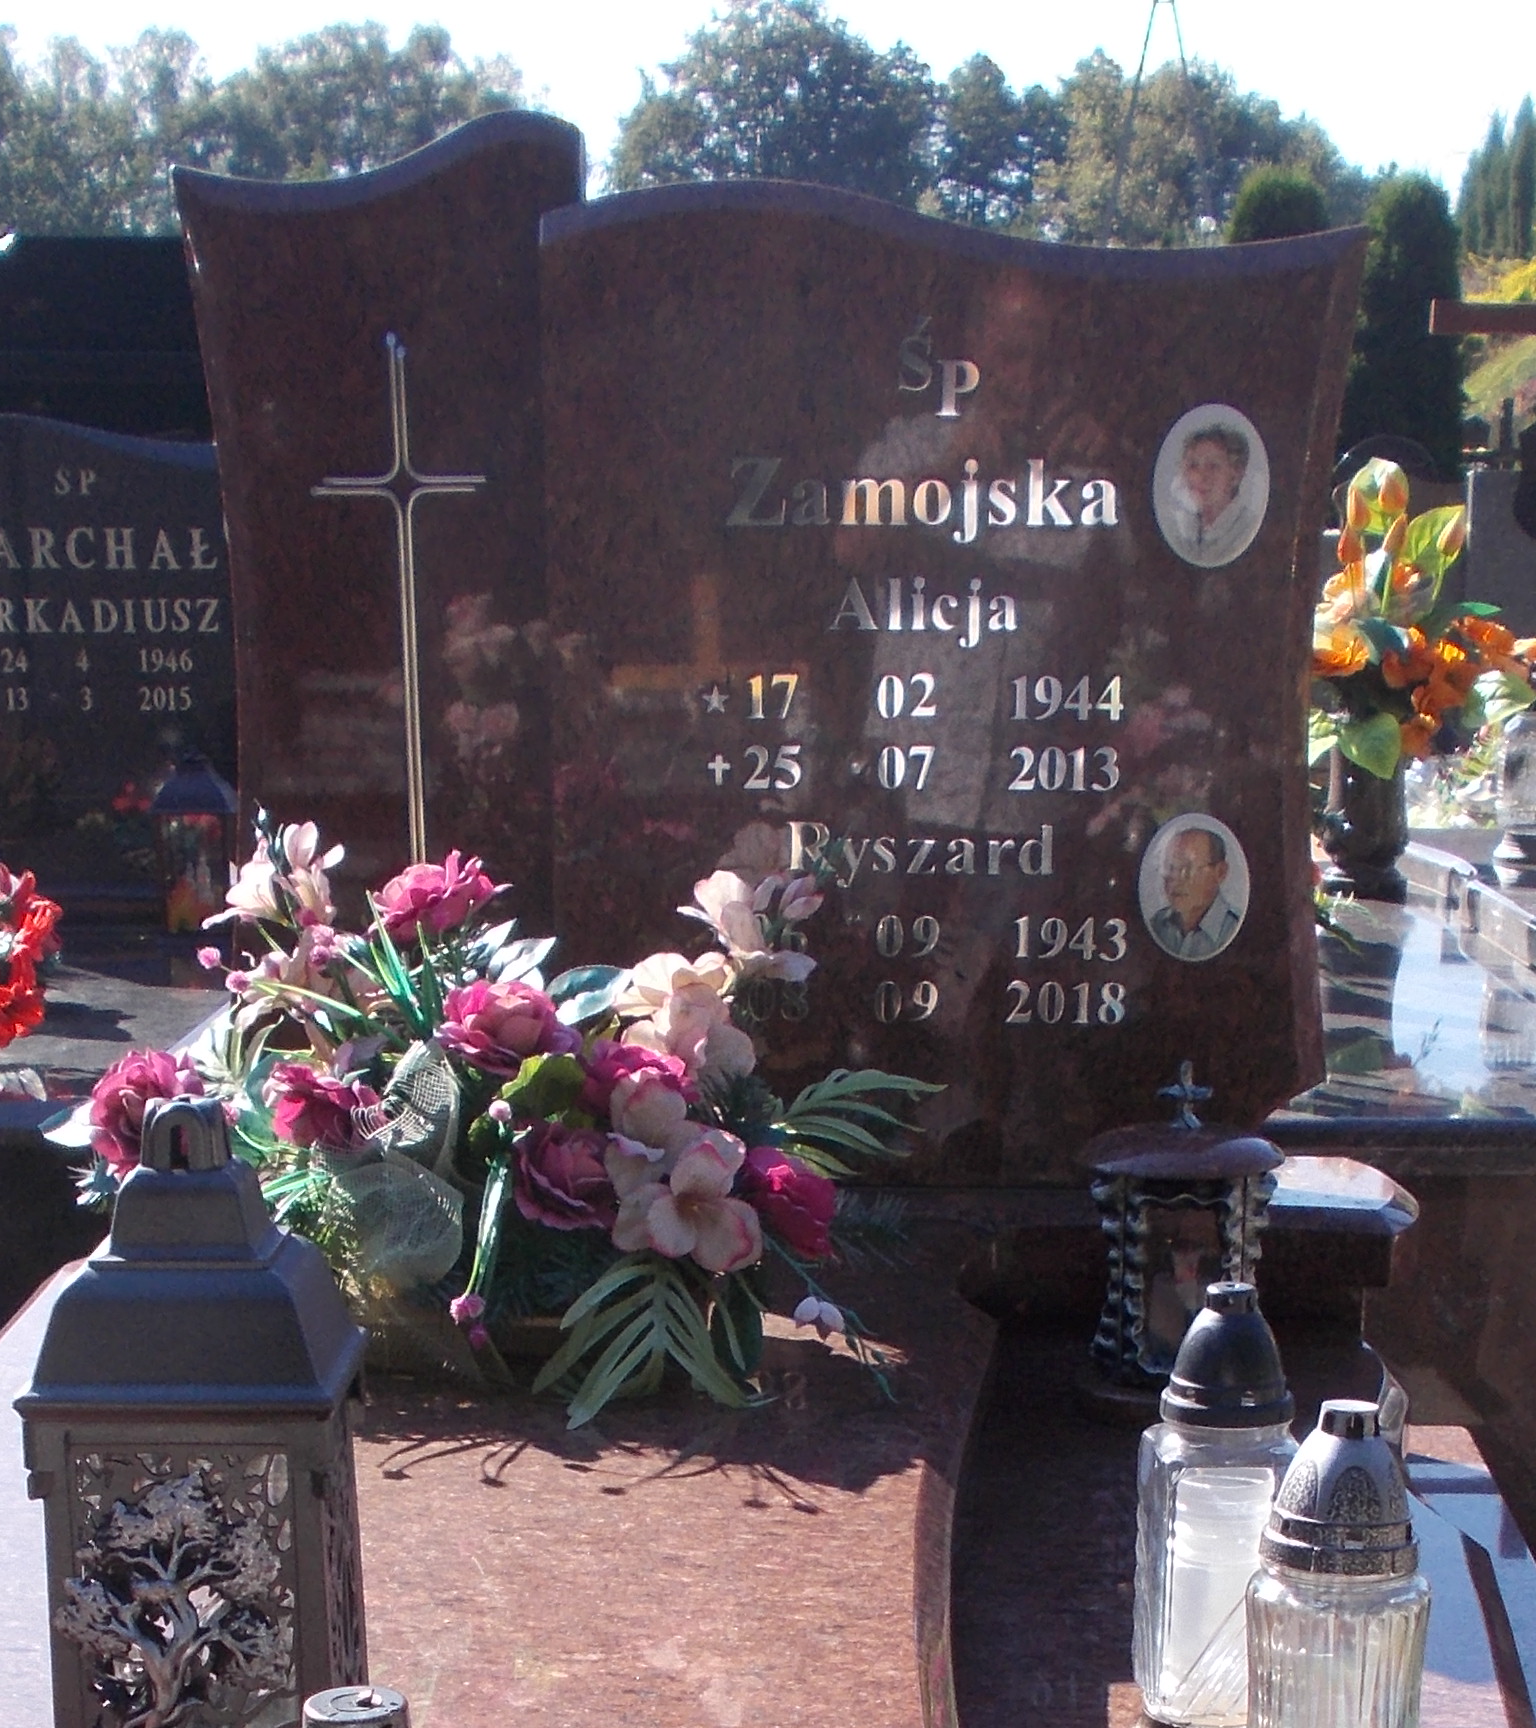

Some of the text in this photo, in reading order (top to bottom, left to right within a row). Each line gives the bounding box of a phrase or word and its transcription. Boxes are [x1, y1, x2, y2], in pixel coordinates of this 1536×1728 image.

[726, 457, 1120, 544] Zamojska
[829, 576, 1018, 648] Alicja
[0, 647, 193, 673] 24 4 1946
[5, 686, 192, 711] 13 3 2015
[746, 673, 1125, 722] 17 02 1944
[743, 745, 1120, 791] 25 07 2013
[786, 821, 1054, 888] Ryszard
[875, 914, 941, 958] 09
[1013, 916, 1127, 962] 1943
[874, 980, 939, 1023] 09
[1004, 979, 1126, 1024] 2018
